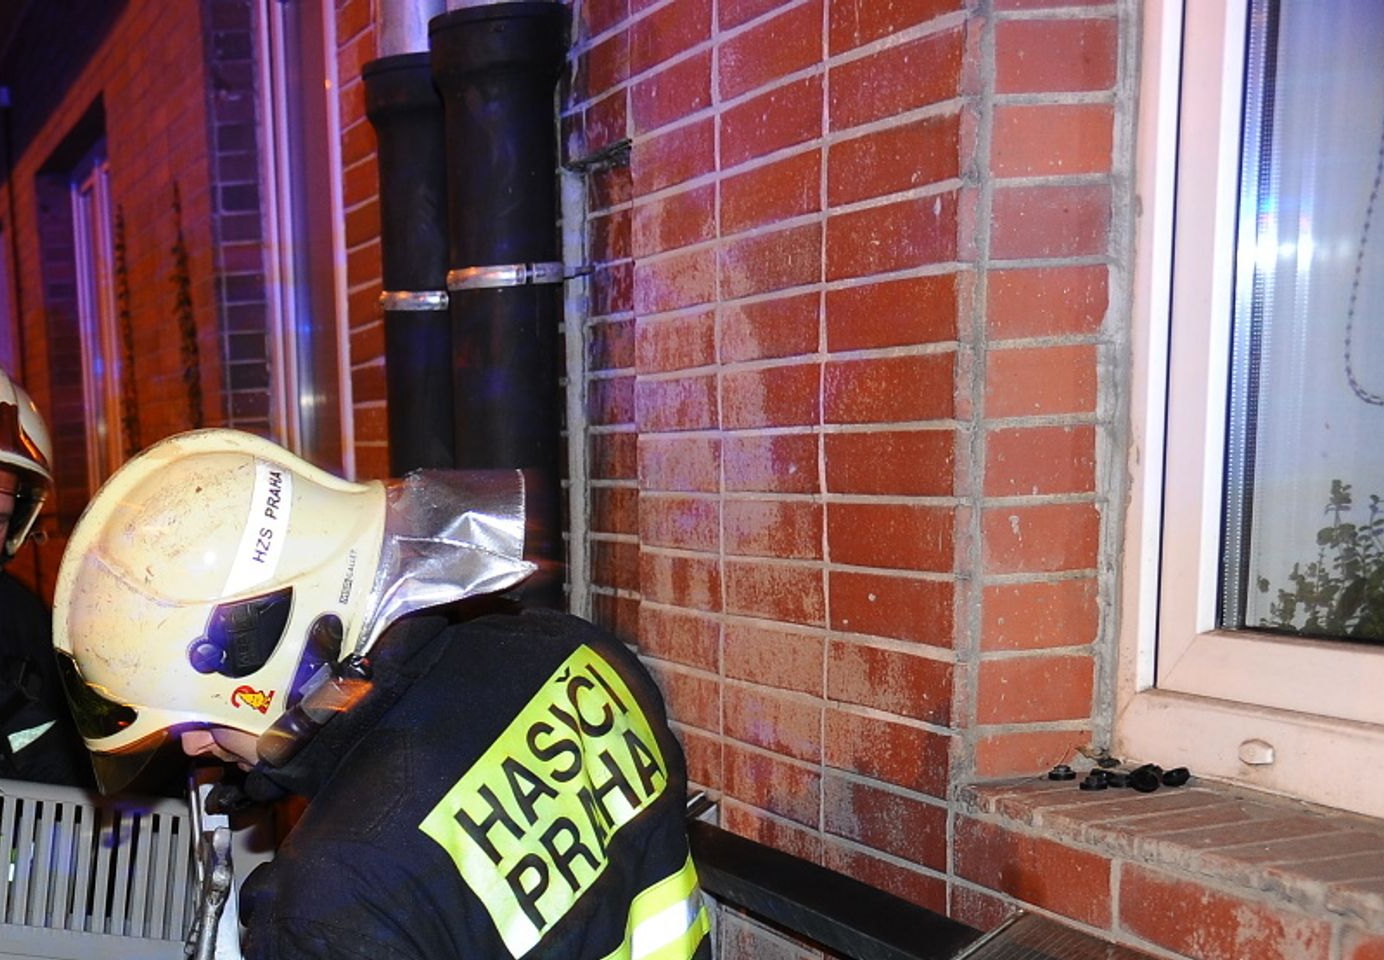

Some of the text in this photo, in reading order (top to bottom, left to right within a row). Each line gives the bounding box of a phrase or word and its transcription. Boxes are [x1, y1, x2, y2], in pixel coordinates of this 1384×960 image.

[252, 471, 283, 563] HZS PRAHA
[453, 664, 629, 867] HASIČI
[504, 727, 665, 932] PRAHA
